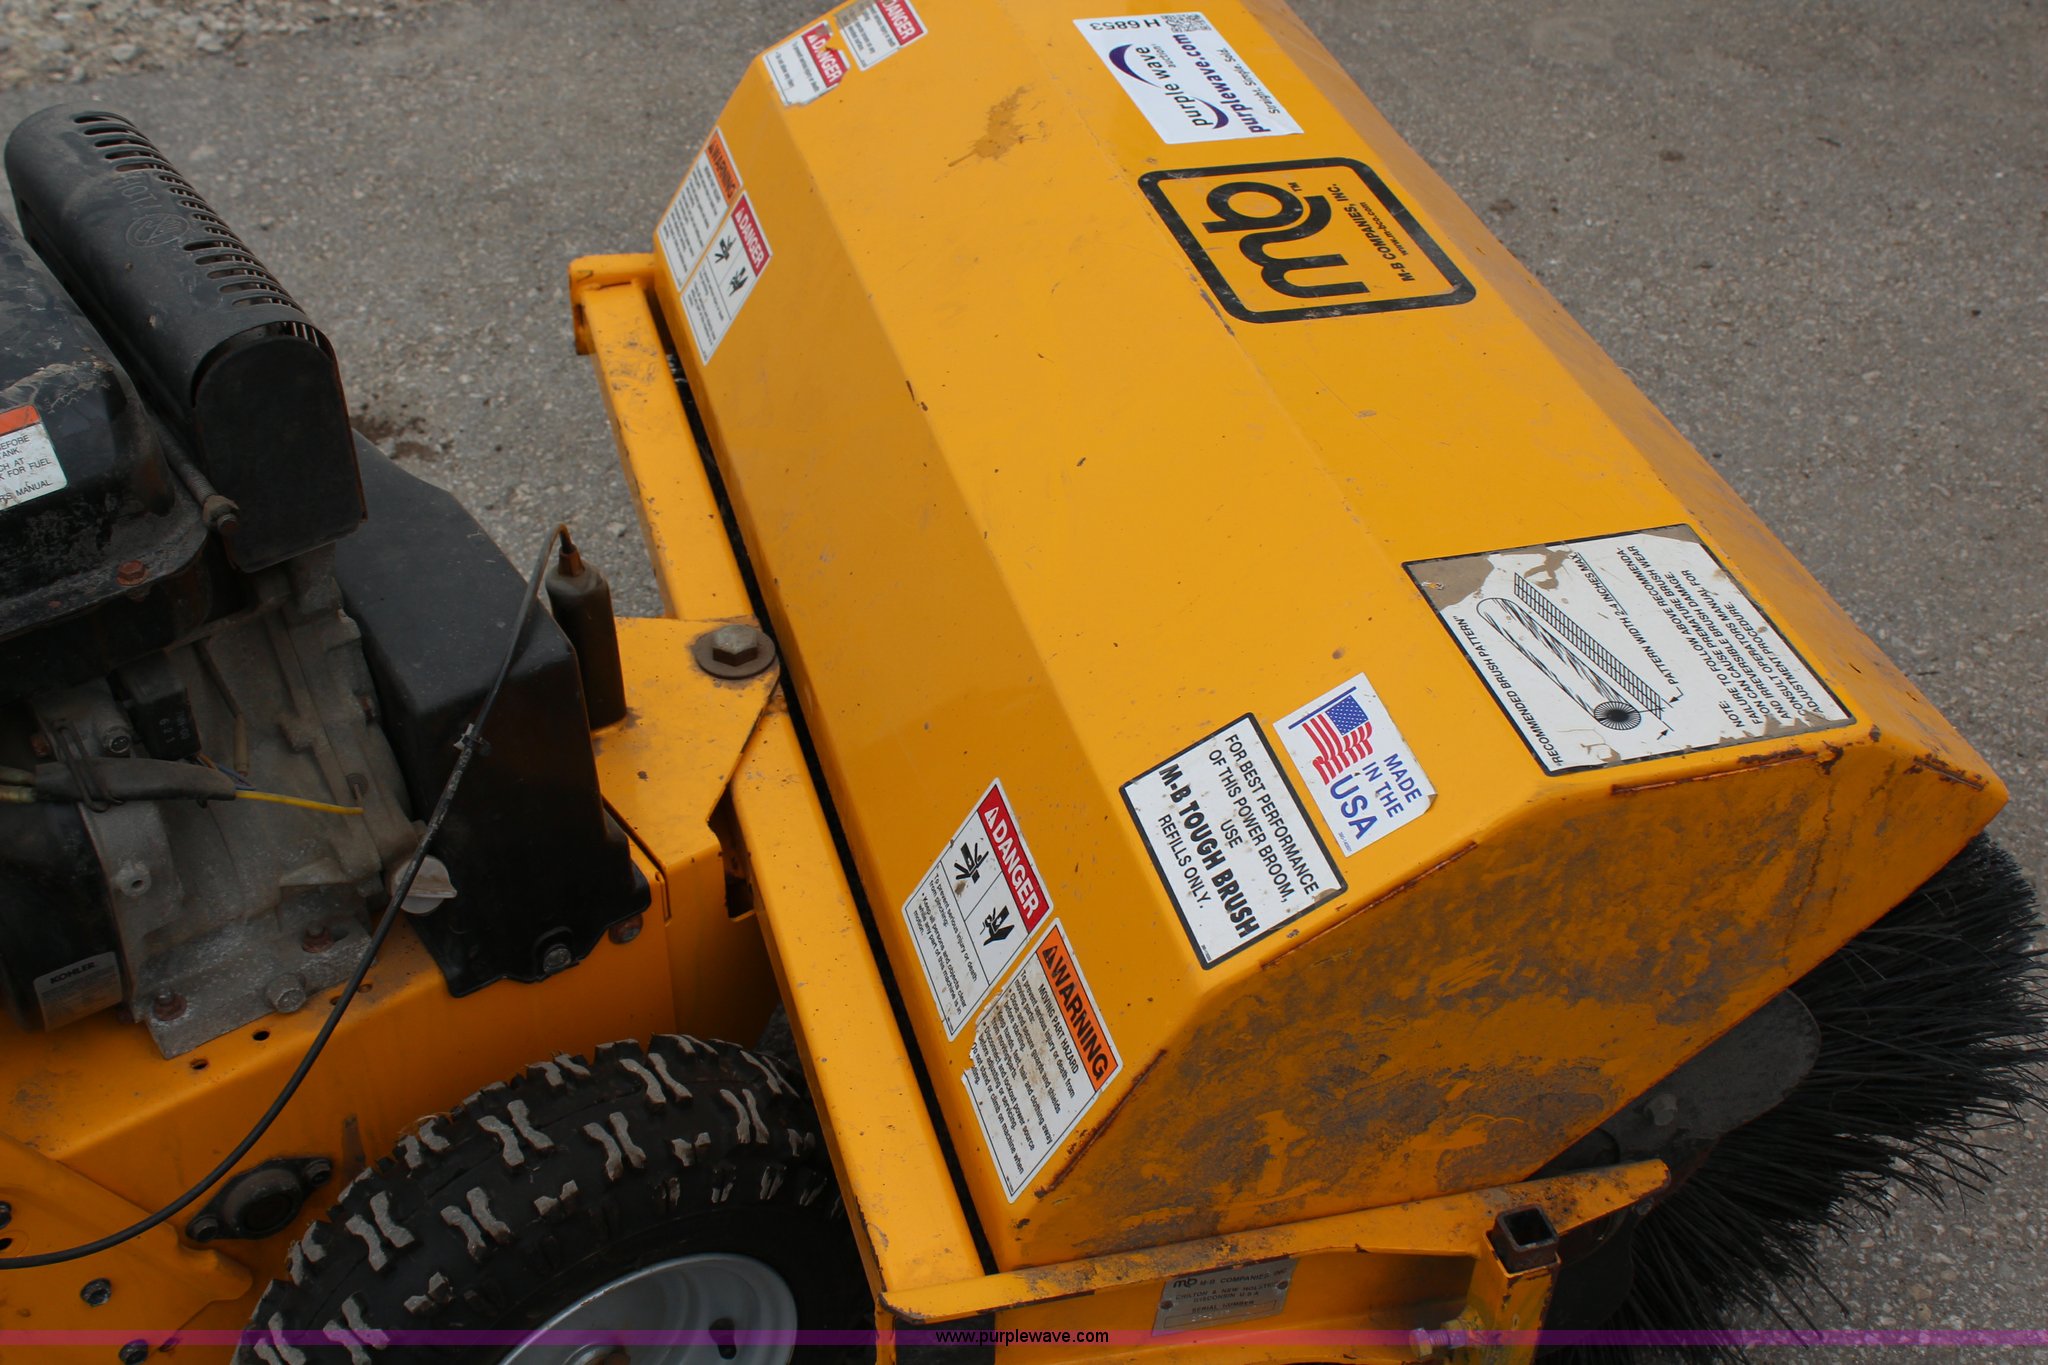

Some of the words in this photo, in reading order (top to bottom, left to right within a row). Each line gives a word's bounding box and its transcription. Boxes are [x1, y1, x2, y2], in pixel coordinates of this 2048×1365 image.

[1133, 46, 1172, 79] wave
[1164, 33, 1272, 133] purplewave.com
[1157, 82, 1214, 126] purple
[1248, 87, 1283, 114] Straight.
[1323, 183, 1350, 201] INC.
[738, 212, 765, 269] DANGER
[1338, 203, 1401, 259] COMPANIES,
[1387, 262, 1415, 281] M-B
[7, 466, 26, 477] FOR
[28, 458, 52, 469] FUEL
[1567, 551, 1590, 571] MAX.
[1626, 545, 1652, 568] WEAR
[1584, 572, 1614, 601] INCHES
[1613, 547, 1668, 606] RECOMMENDA-
[1645, 569, 1675, 596] BRUSH
[1662, 571, 1699, 607] DAMAGE.
[1680, 569, 1701, 585] FOR
[1607, 603, 1625, 615] 2-4
[1695, 586, 1730, 621] MANUAL
[1618, 617, 1647, 644] WIDTH
[1661, 607, 1691, 635] ABOVE
[1668, 597, 1717, 648] PREMATURE
[1693, 608, 1724, 637] BRUSH
[1722, 601, 1773, 654] PROCEDURE.
[1685, 636, 1721, 671] FOLLOW
[1724, 622, 1774, 673] OPERATORS
[1482, 658, 1512, 688] BRUSH
[1640, 644, 1679, 684] PATTERN
[1711, 649, 1742, 678] CAUSE
[1718, 638, 1774, 698] IRREVERSIBLE
[1715, 673, 1733, 686] TO
[1736, 680, 1759, 699] CAN
[1768, 656, 1824, 713] ADJUSTMENT
[1726, 687, 1764, 724] FAILURE
[1767, 674, 1809, 715] CONSULT
[1768, 699, 1791, 719] AND
[1716, 700, 1745, 727] NOTE:
[1361, 761, 1383, 782] IN
[1373, 780, 1404, 817] THE
[1383, 752, 1422, 804] MADE
[1224, 733, 1248, 763] FOR
[1238, 759, 1265, 795] BEST
[1256, 793, 1319, 895] PERFORMANCE
[1327, 773, 1381, 840] USA
[1207, 747, 1227, 769] OF
[1217, 766, 1242, 799] THIS
[1232, 795, 1267, 846] POWER
[1255, 843, 1297, 903] BROOM,
[1218, 818, 1243, 849] USE
[1157, 761, 1193, 805] M-B
[1176, 799, 1226, 871] TOUGH
[1210, 867, 1260, 939] BRUSH
[1157, 813, 1192, 868] REFILLS
[1182, 864, 1213, 909] ONLY.
[991, 818, 1040, 920] DANGER
[928, 878, 938, 898] from
[936, 882, 949, 910] prevent
[946, 907, 959, 934] serious
[955, 931, 966, 955] injury
[963, 951, 969, 962] or
[966, 959, 977, 983] death
[917, 901, 927, 922] while
[923, 920, 931, 936] any
[928, 932, 937, 950] part
[934, 946, 940, 958] of
[937, 954, 945, 971] this
[942, 967, 956, 1000] machine
[922, 895, 932, 916] Keep
[931, 922, 945, 952] persons
[942, 948, 950, 964] and
[946, 961, 960, 991] objects
[957, 987, 967, 1009] clear
[50, 961, 95, 984] KOHLER
[1019, 969, 1027, 982] To
[1012, 977, 1027, 1006] moving
[1023, 979, 1037, 1007] prevent
[990, 1016, 1001, 1035] from
[1002, 999, 1016, 1024] before
[1033, 1003, 1048, 1031] serious
[1048, 955, 1110, 1081] WARNING
[1001, 1025, 1016, 1053] hands,
[1037, 982, 1056, 1019] MOVING
[1050, 1014, 1065, 1040] PART
[1060, 1037, 1079, 1075] HAZARD
[1043, 1028, 1056, 1053] injury
[974, 1051, 983, 1067] not
[995, 1032, 1010, 1061] moving
[1008, 991, 1021, 1014] Close
[1016, 1010, 1026, 1027] and
[1021, 1024, 1035, 1050] secure
[1030, 1047, 1045, 1075] guards
[1041, 1071, 1051, 1088] and
[1047, 1085, 1062, 1114] shields
[1052, 1049, 1059, 1061] or
[977, 1031, 991, 1057] before
[984, 1053, 1003, 1089] adjusting
[998, 1086, 1004, 1096] or
[978, 1063, 991, 1086] stand
[1018, 1064, 1028, 1082] hair
[1055, 1057, 1068, 1081] death
[982, 1024, 1003, 1065] Disconnect
[997, 1061, 1007, 1078] and
[1002, 1075, 1018, 1105] lockout
[1012, 1101, 1026, 1127] power
[1021, 1124, 1035, 1152] source
[986, 1083, 993, 1094] or
[1024, 1079, 1033, 1096] and
[1064, 1077, 1076, 1099] from
[989, 1091, 1002, 1114] climb
[1028, 1093, 1045, 1126] clothing
[997, 1111, 1004, 1124] on
[1000, 1121, 1017, 1155] machine
[1040, 1122, 1053, 1146] away
[1012, 1151, 1025, 1175] when
